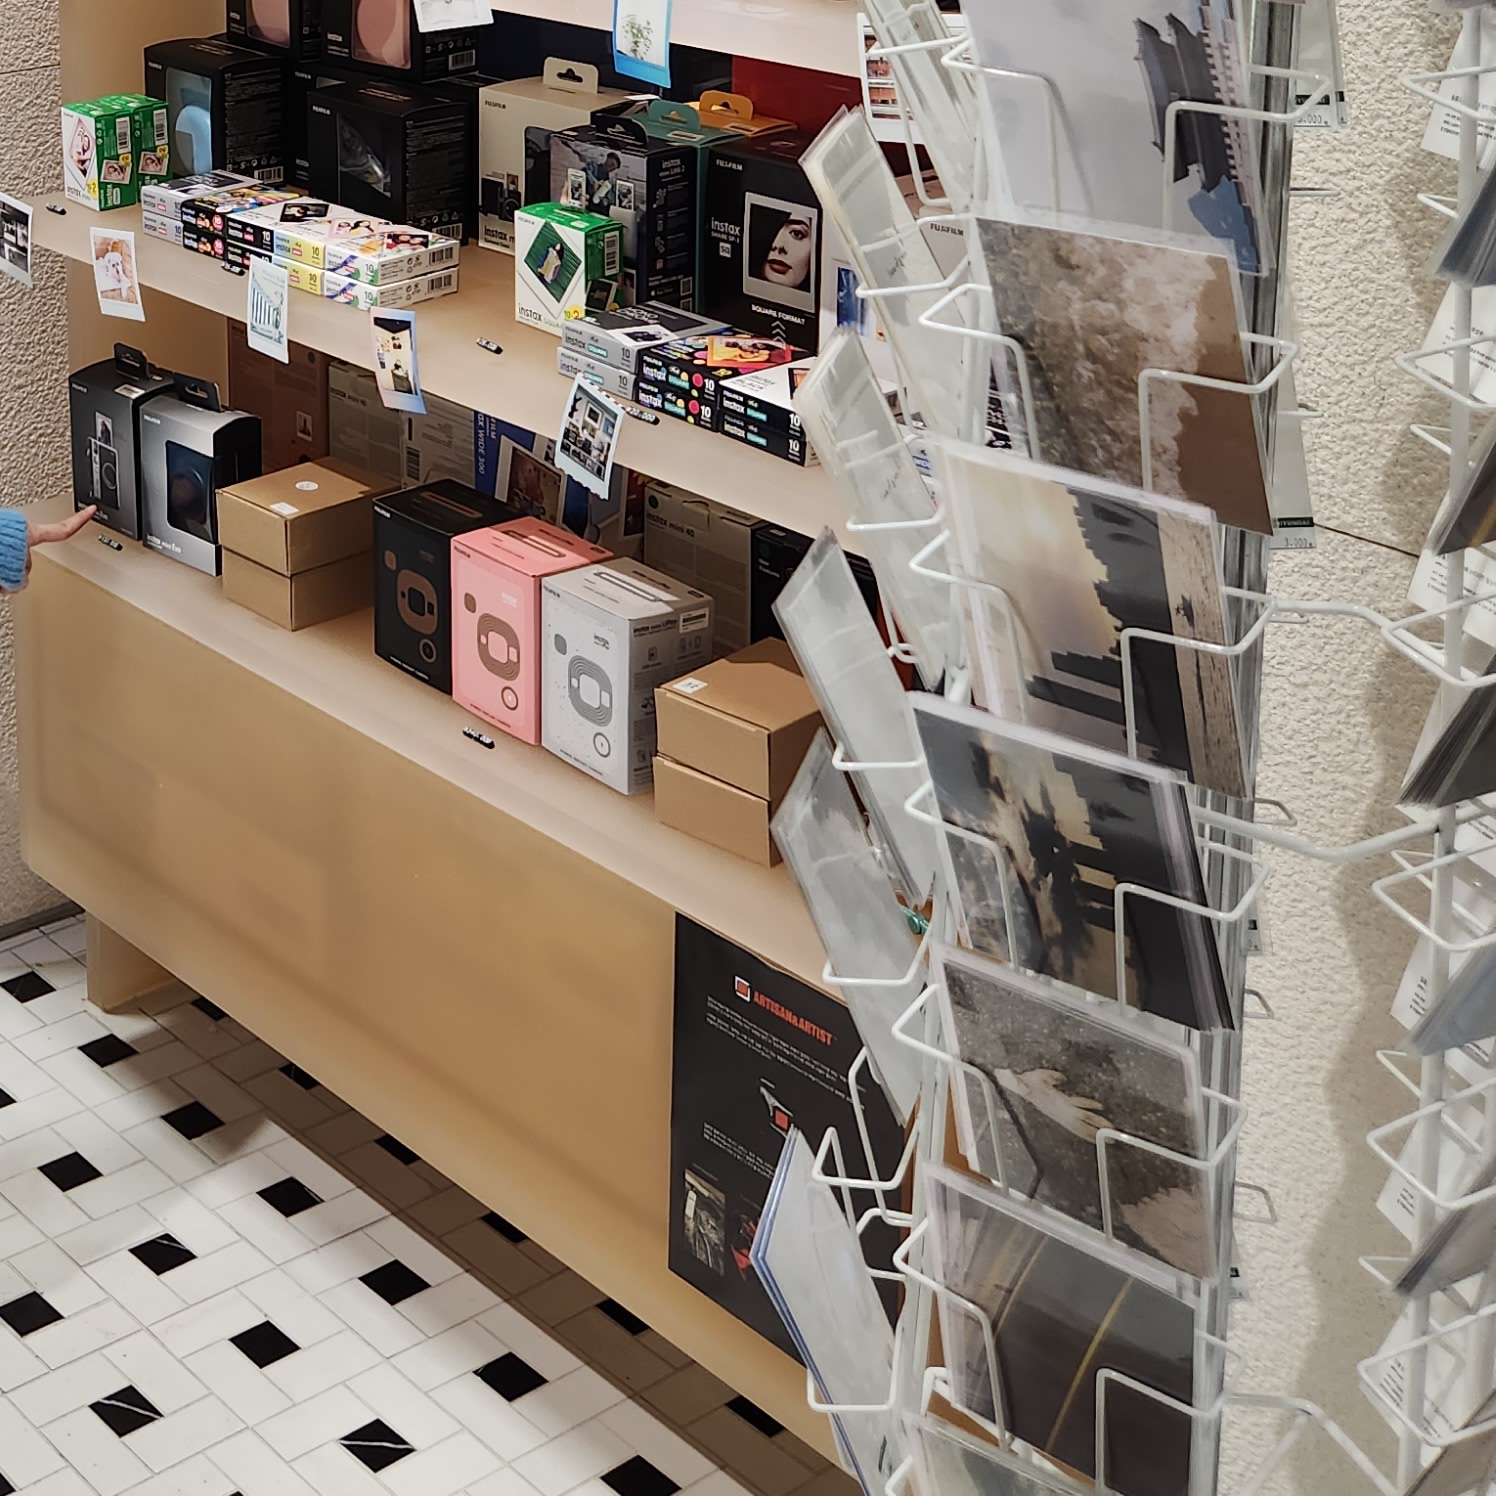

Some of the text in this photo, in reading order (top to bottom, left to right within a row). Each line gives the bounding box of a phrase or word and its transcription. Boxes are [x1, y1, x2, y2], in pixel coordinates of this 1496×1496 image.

[710, 217, 741, 236] instax
[930, 222, 964, 237] FUJIFILM
[261, 230, 271, 241] 10
[485, 225, 508, 242] instax
[312, 246, 320, 257] 10
[365, 263, 374, 274] 10
[308, 273, 317, 283] 10
[364, 291, 373, 301] 10
[518, 303, 543, 322] instax
[751, 304, 806, 325] SQUARE FORMAT
[621, 347, 631, 359] 10
[619, 375, 628, 387] 10
[704, 378, 715, 391] 10
[700, 405, 711, 419] 10
[789, 413, 801, 426] 10
[478, 429, 486, 452] WIDE
[788, 438, 800, 452] 10
[754, 991, 833, 1046] ARTISAN&ARTIST
